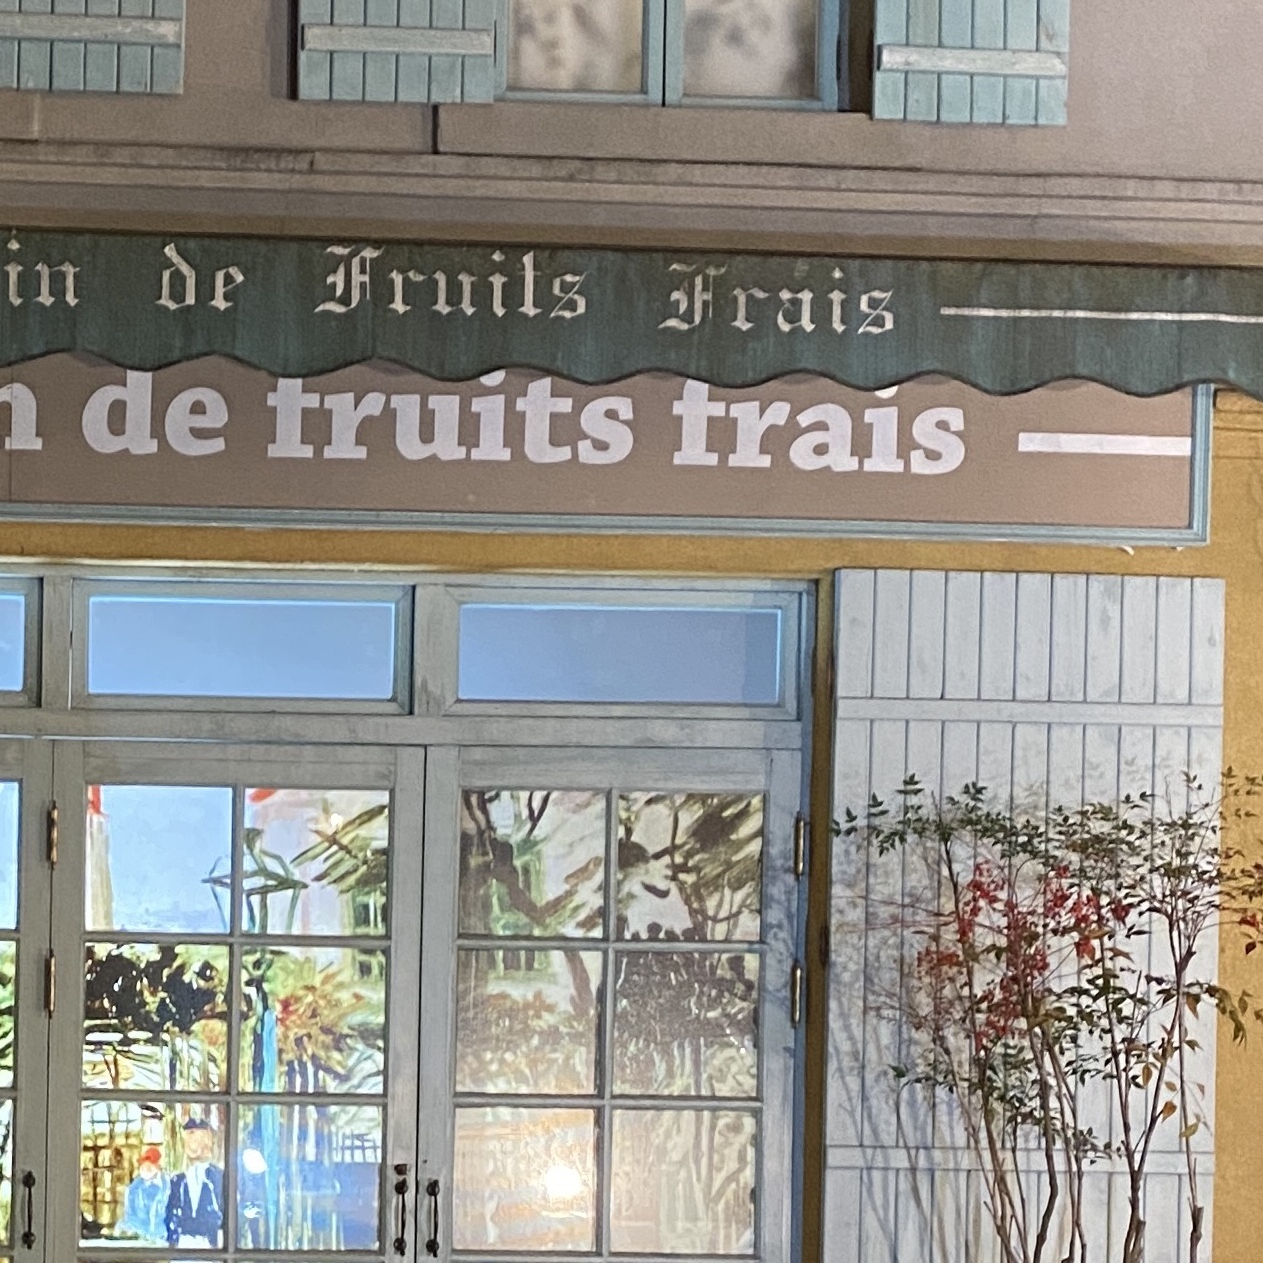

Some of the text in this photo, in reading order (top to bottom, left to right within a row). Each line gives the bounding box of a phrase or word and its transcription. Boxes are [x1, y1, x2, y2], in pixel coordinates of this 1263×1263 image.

[155, 242, 245, 311] de
[314, 245, 588, 318] Fruits
[658, 262, 895, 334] Frais
[81, 370, 229, 457] de
[266, 370, 634, 465] fruits
[672, 378, 966, 475] frais
